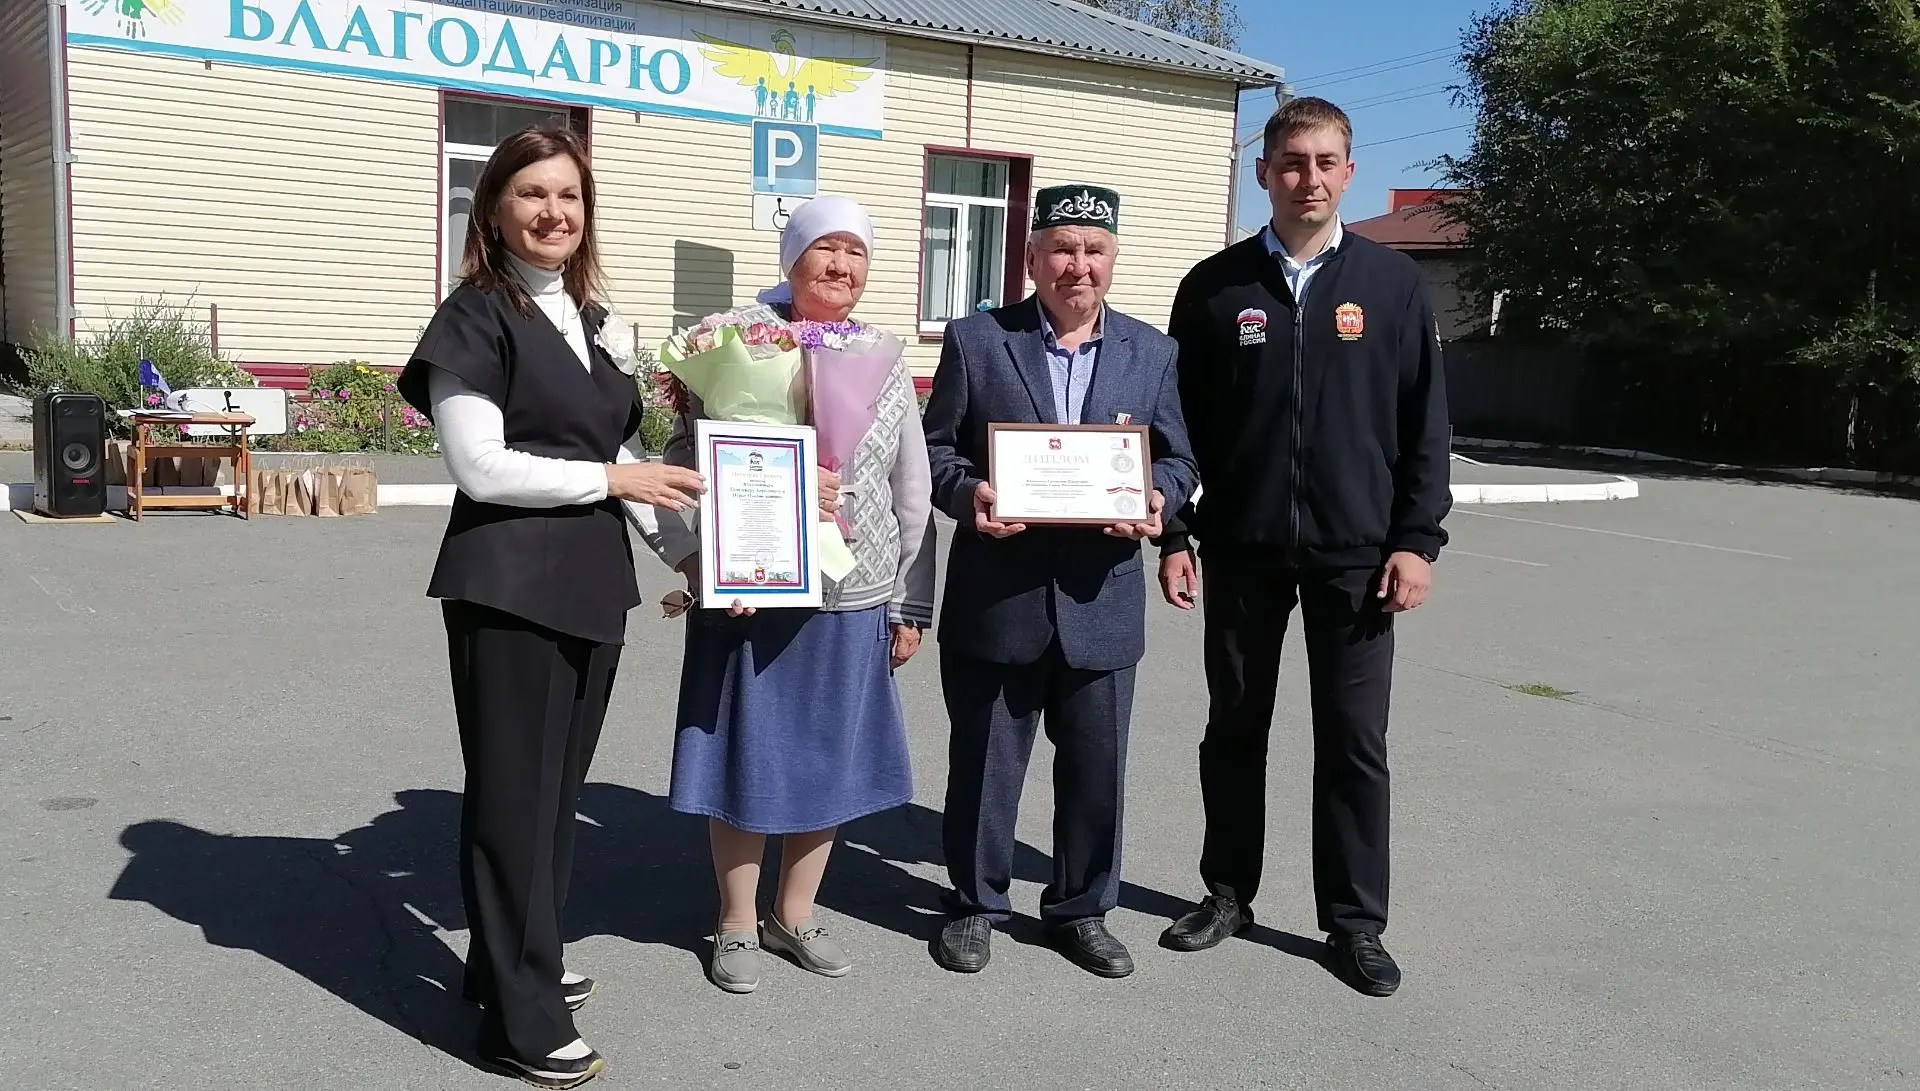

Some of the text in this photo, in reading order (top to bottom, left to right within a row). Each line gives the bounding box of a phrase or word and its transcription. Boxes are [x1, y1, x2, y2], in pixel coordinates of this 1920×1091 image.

[527, 6, 536, 16] и
[540, 8, 636, 31] реабилитации
[224, 0, 691, 95] БЛАГОДАРЮ
[768, 129, 803, 185] P
